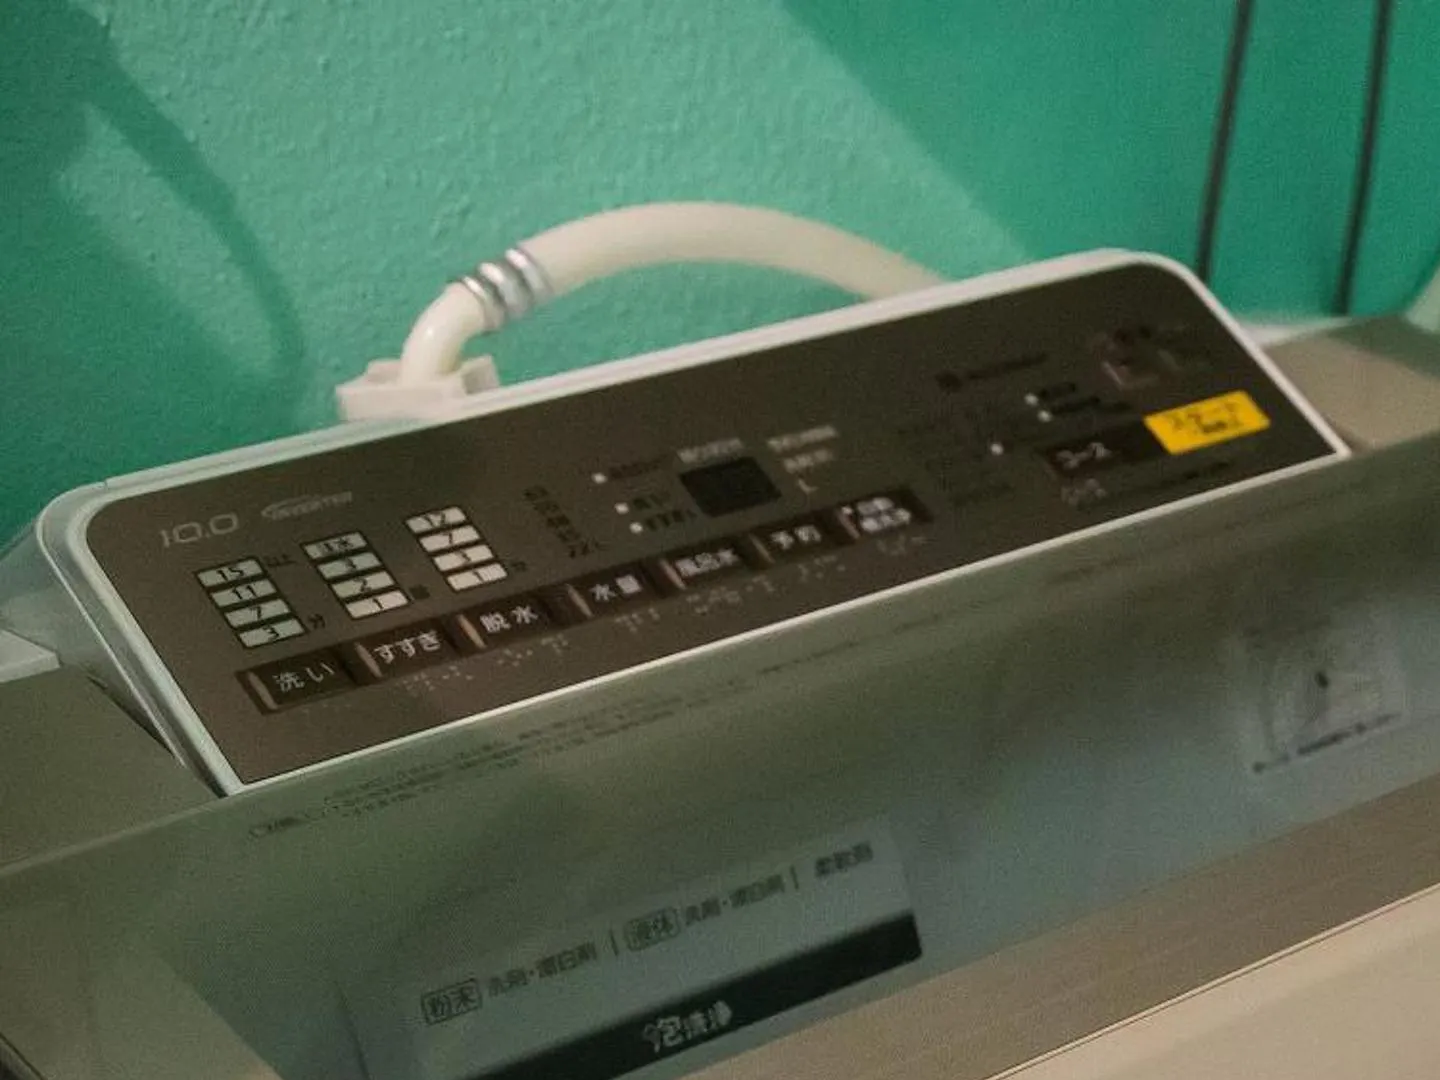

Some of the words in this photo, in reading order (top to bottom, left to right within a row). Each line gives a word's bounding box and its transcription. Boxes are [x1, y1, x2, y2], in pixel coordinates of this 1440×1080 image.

[160, 513, 239, 548] 10.0
[216, 566, 244, 582] 15
[231, 584, 258, 601] 11
[273, 660, 335, 692] 洗い
[373, 629, 441, 665] すすぎ
